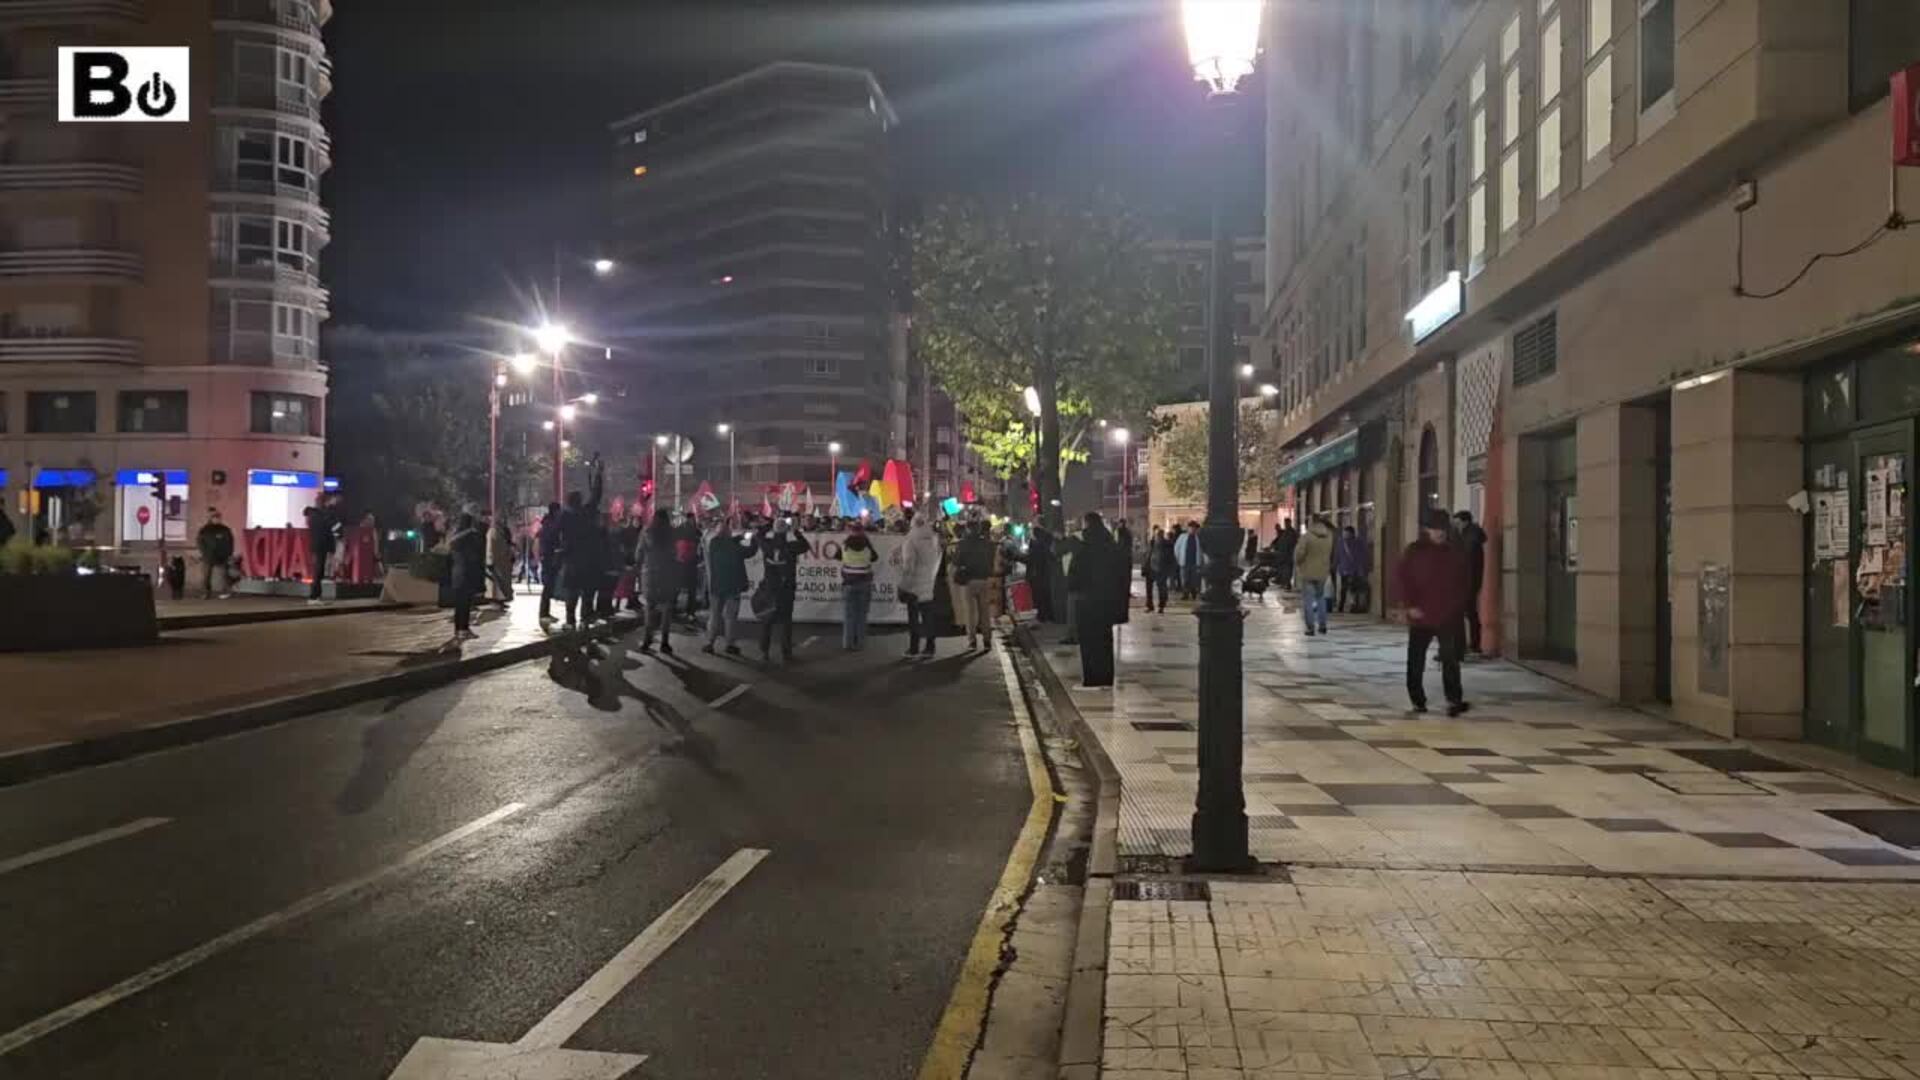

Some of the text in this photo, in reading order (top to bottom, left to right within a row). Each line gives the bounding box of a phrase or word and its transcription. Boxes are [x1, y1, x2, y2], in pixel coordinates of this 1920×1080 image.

[804, 540, 840, 560] NO
[799, 566, 838, 577] CIERRE
[796, 582, 826, 593] CADO
